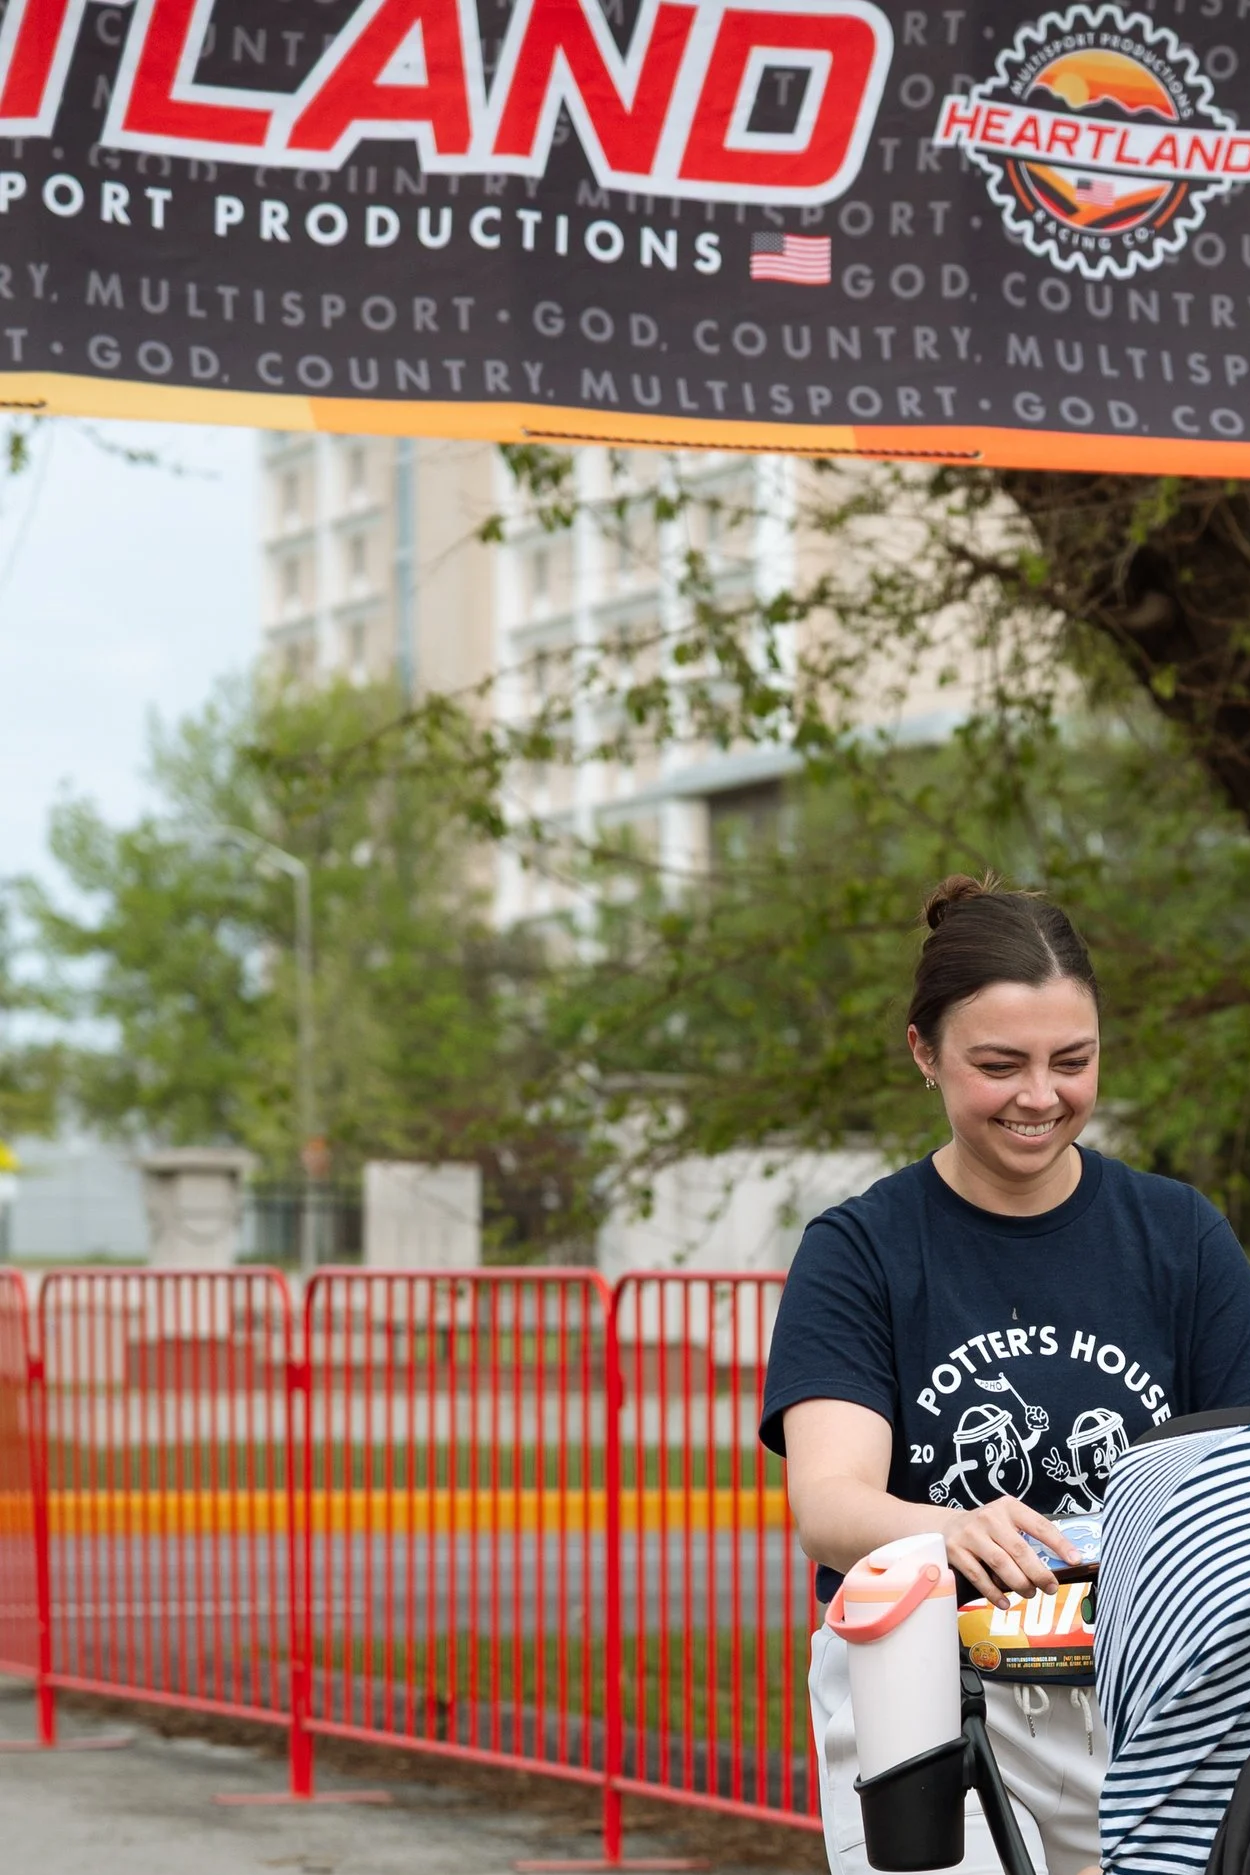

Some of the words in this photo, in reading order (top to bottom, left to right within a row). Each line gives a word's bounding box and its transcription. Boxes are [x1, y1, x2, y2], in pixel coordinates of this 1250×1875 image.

[1010, 32, 1096, 97] MULTISPORT
[1099, 32, 1195, 120] PRODUCTIONS
[213, 194, 723, 275] PRODUCTIONS
[1033, 208, 1112, 252] RACING
[86, 269, 475, 333] MULTISPORT
[580, 367, 957, 418] MULTISPORT
[916, 1325, 1059, 1416] POTTER'S
[1069, 1330, 1171, 1427] HOUSE
[909, 1444, 935, 1464] 20
